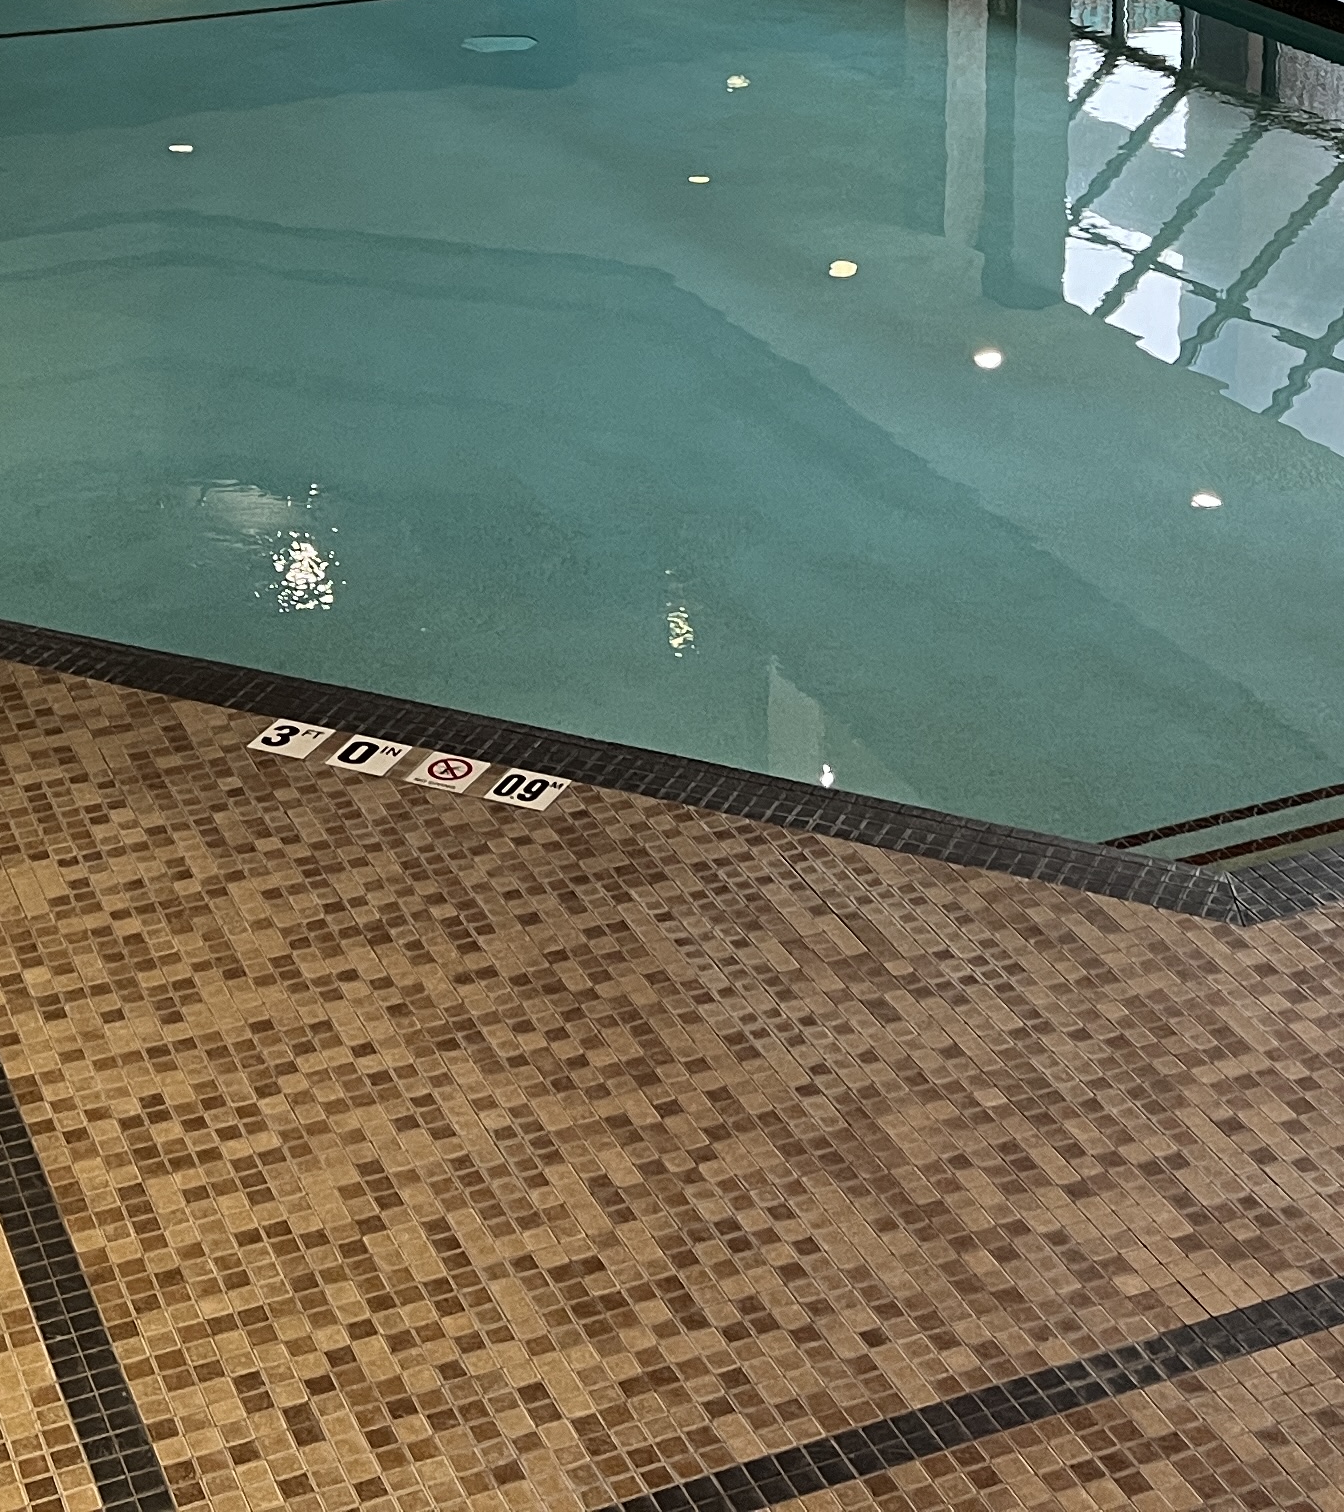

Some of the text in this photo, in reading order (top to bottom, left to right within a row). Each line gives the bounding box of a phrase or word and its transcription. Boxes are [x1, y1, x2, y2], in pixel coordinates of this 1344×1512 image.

[261, 725, 300, 747] 3
[301, 729, 325, 739] FT
[337, 741, 380, 764] 0
[380, 746, 403, 757] IN
